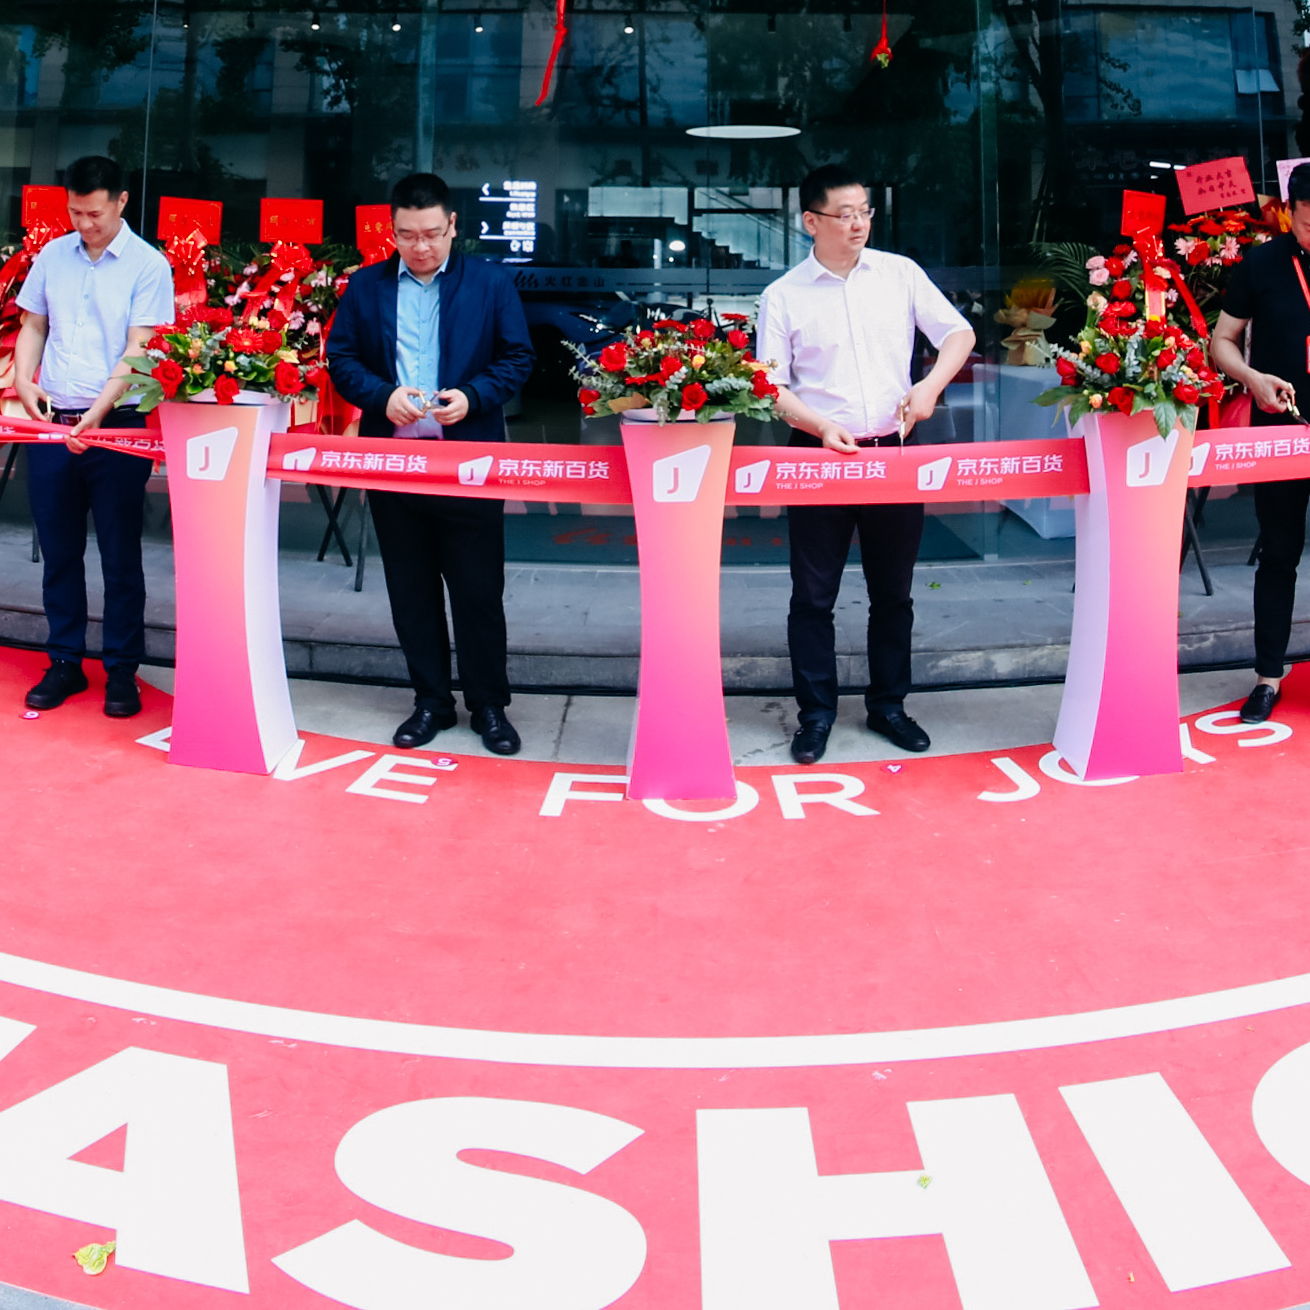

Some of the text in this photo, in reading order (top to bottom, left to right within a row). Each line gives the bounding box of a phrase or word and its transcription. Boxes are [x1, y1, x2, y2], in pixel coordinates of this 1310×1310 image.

[1215, 438, 1310, 460] 京东新百货
[321, 450, 427, 473] 京东新百货
[498, 459, 609, 479] 京东新百货
[775, 461, 886, 480] 京东新百货
[957, 454, 1063, 474] 京东新百货
[980, 477, 1002, 485] SHOP
